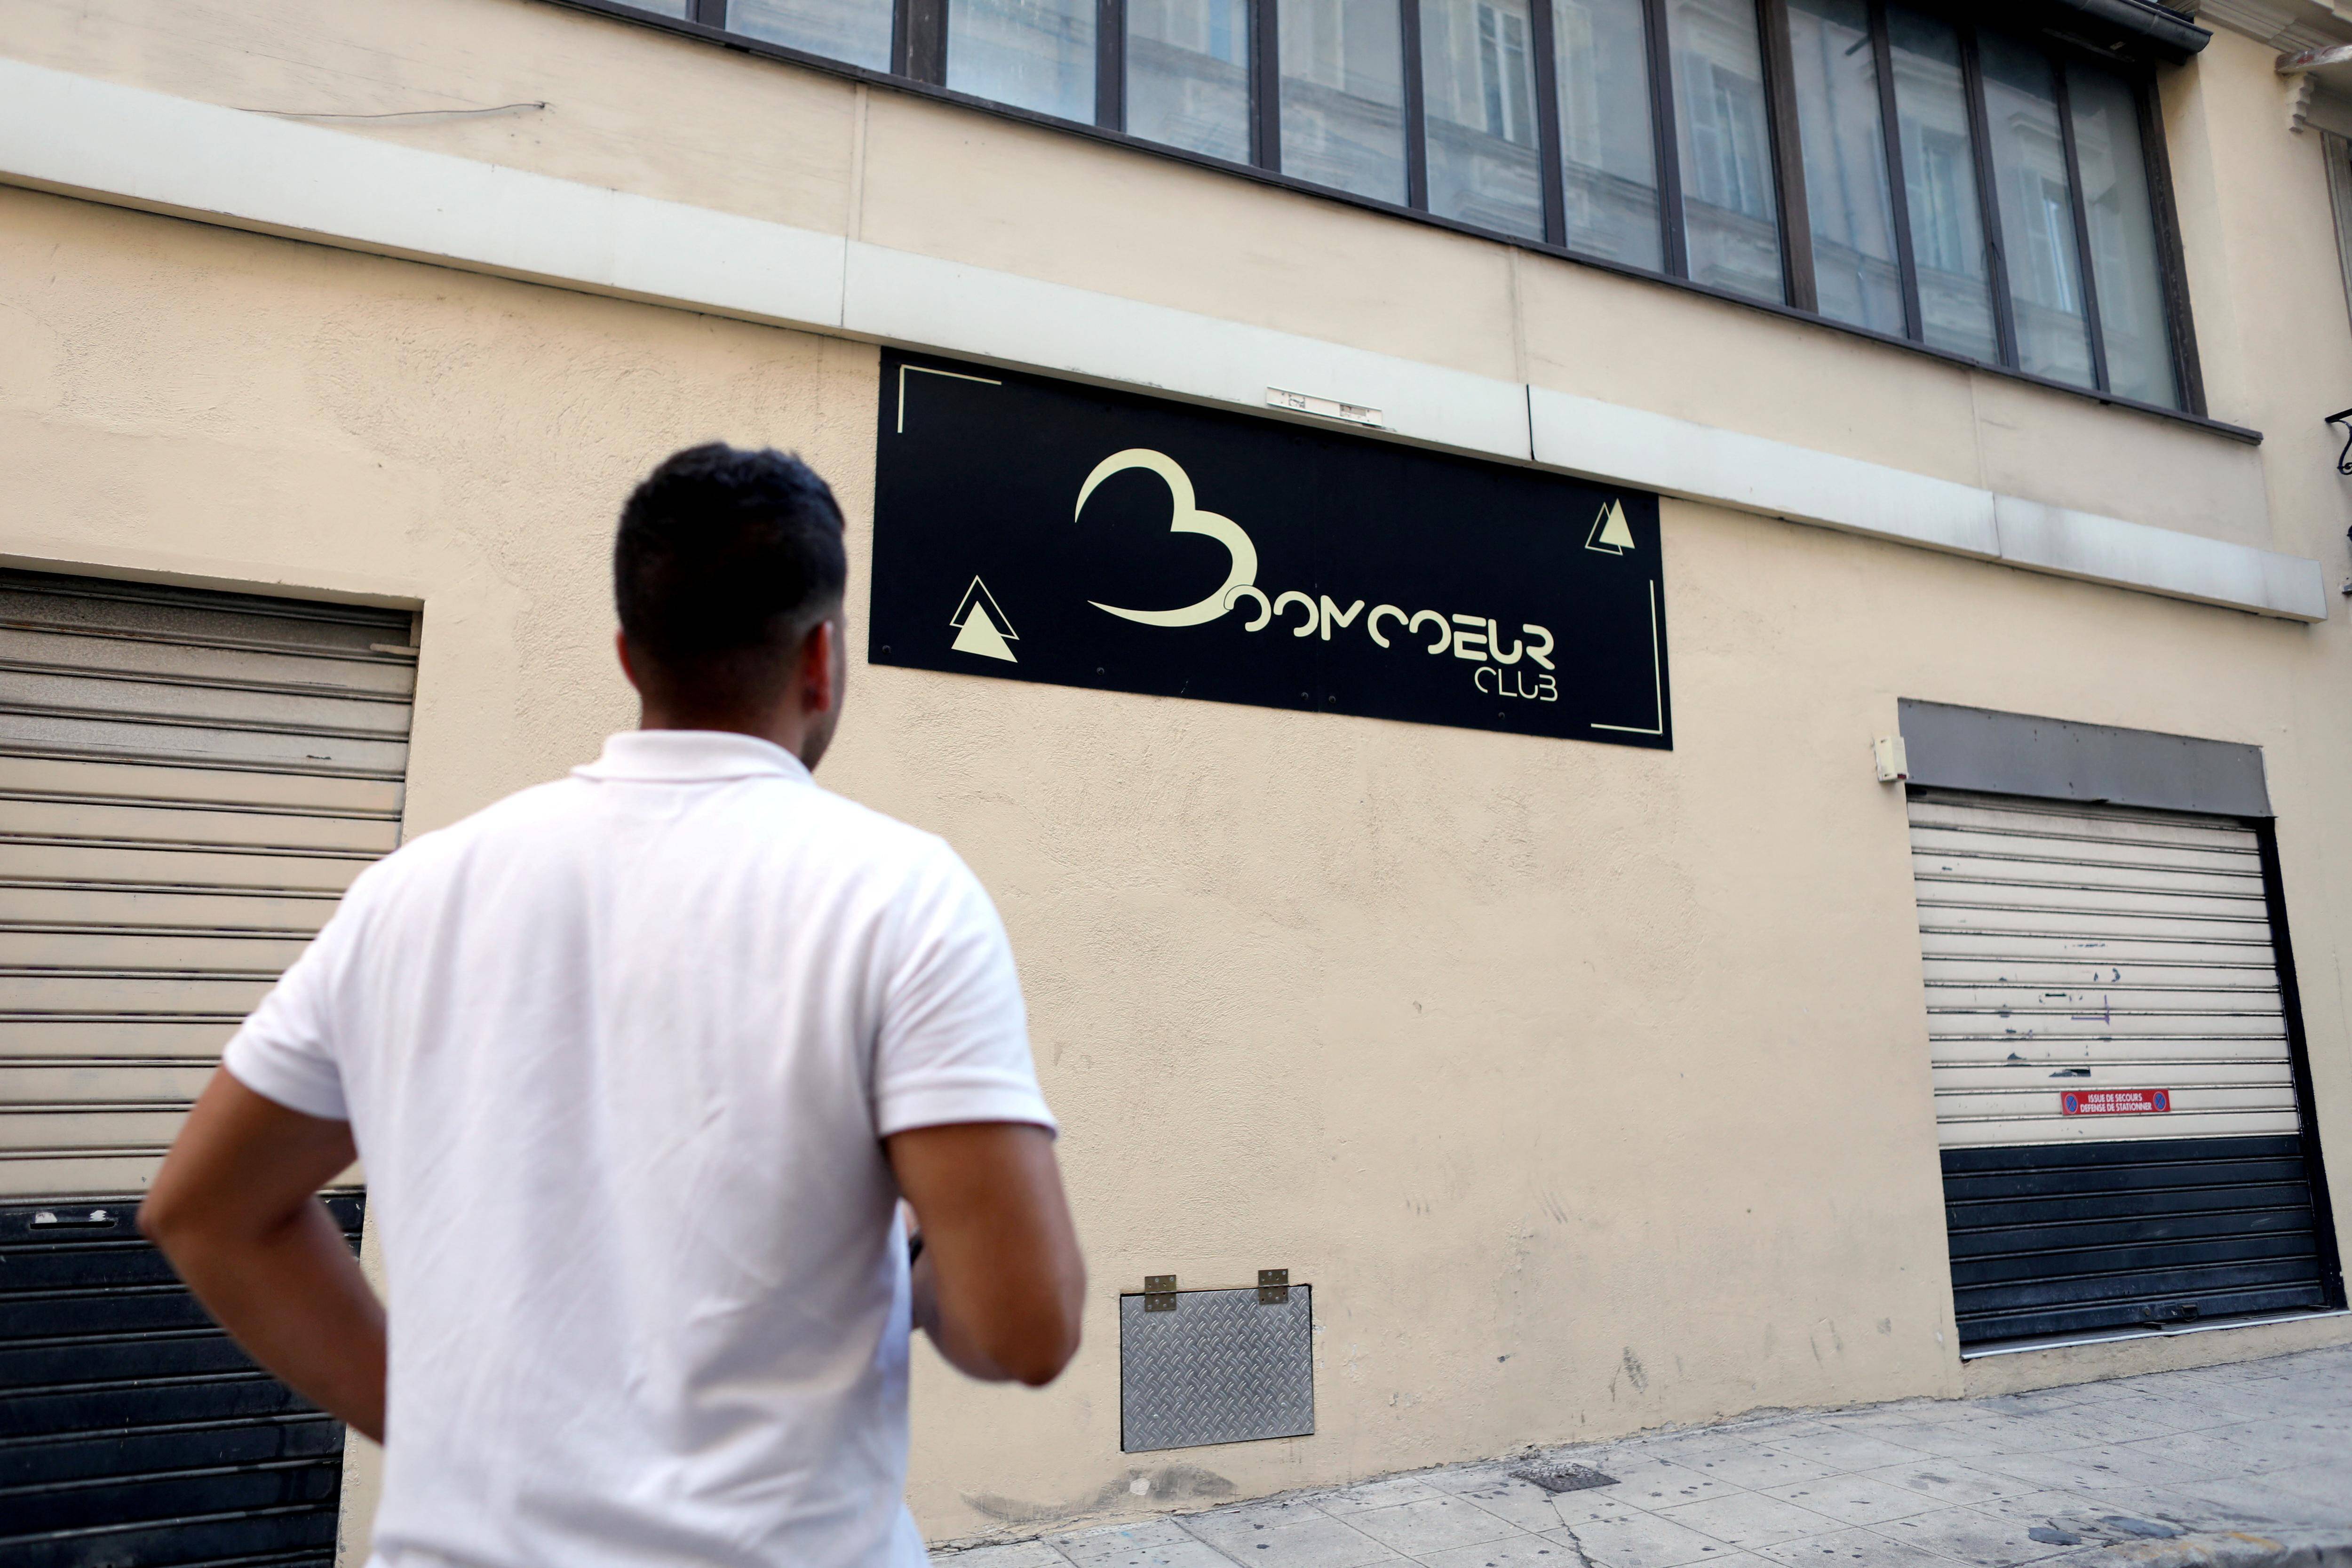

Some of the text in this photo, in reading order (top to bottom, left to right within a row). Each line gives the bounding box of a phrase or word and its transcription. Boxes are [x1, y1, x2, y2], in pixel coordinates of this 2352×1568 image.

[1474, 666, 1558, 701] CLUB
[2088, 1093, 2142, 1103] ISSUE DE SECOURS
[2080, 1102, 2152, 1113] DEFENSE DE STATIONNER
